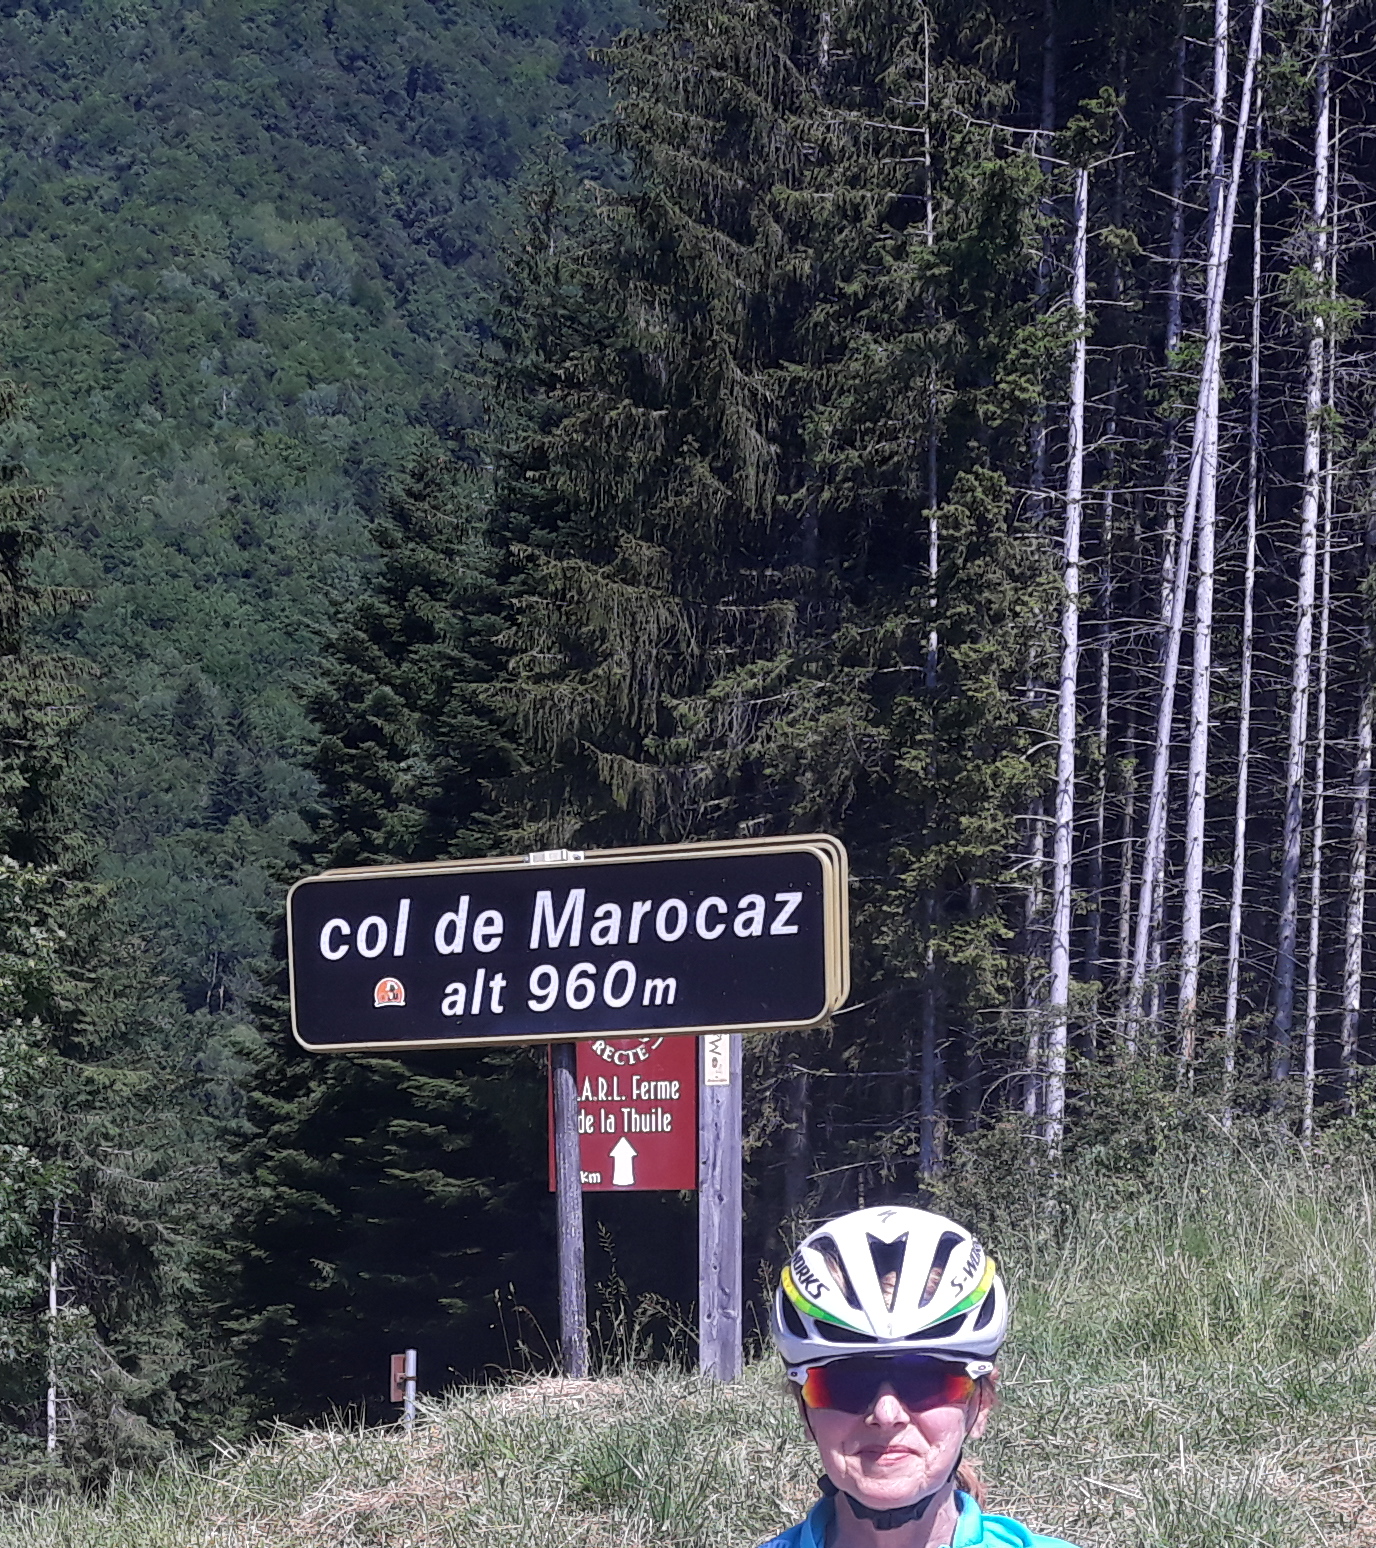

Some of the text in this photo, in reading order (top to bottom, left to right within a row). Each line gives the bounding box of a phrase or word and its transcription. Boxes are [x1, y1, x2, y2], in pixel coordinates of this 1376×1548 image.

[320, 888, 804, 961] col de Marocaz
[440, 968, 506, 1017] alt
[632, 1075, 680, 1101] Ferme
[577, 1107, 672, 1134] de la Thuile
